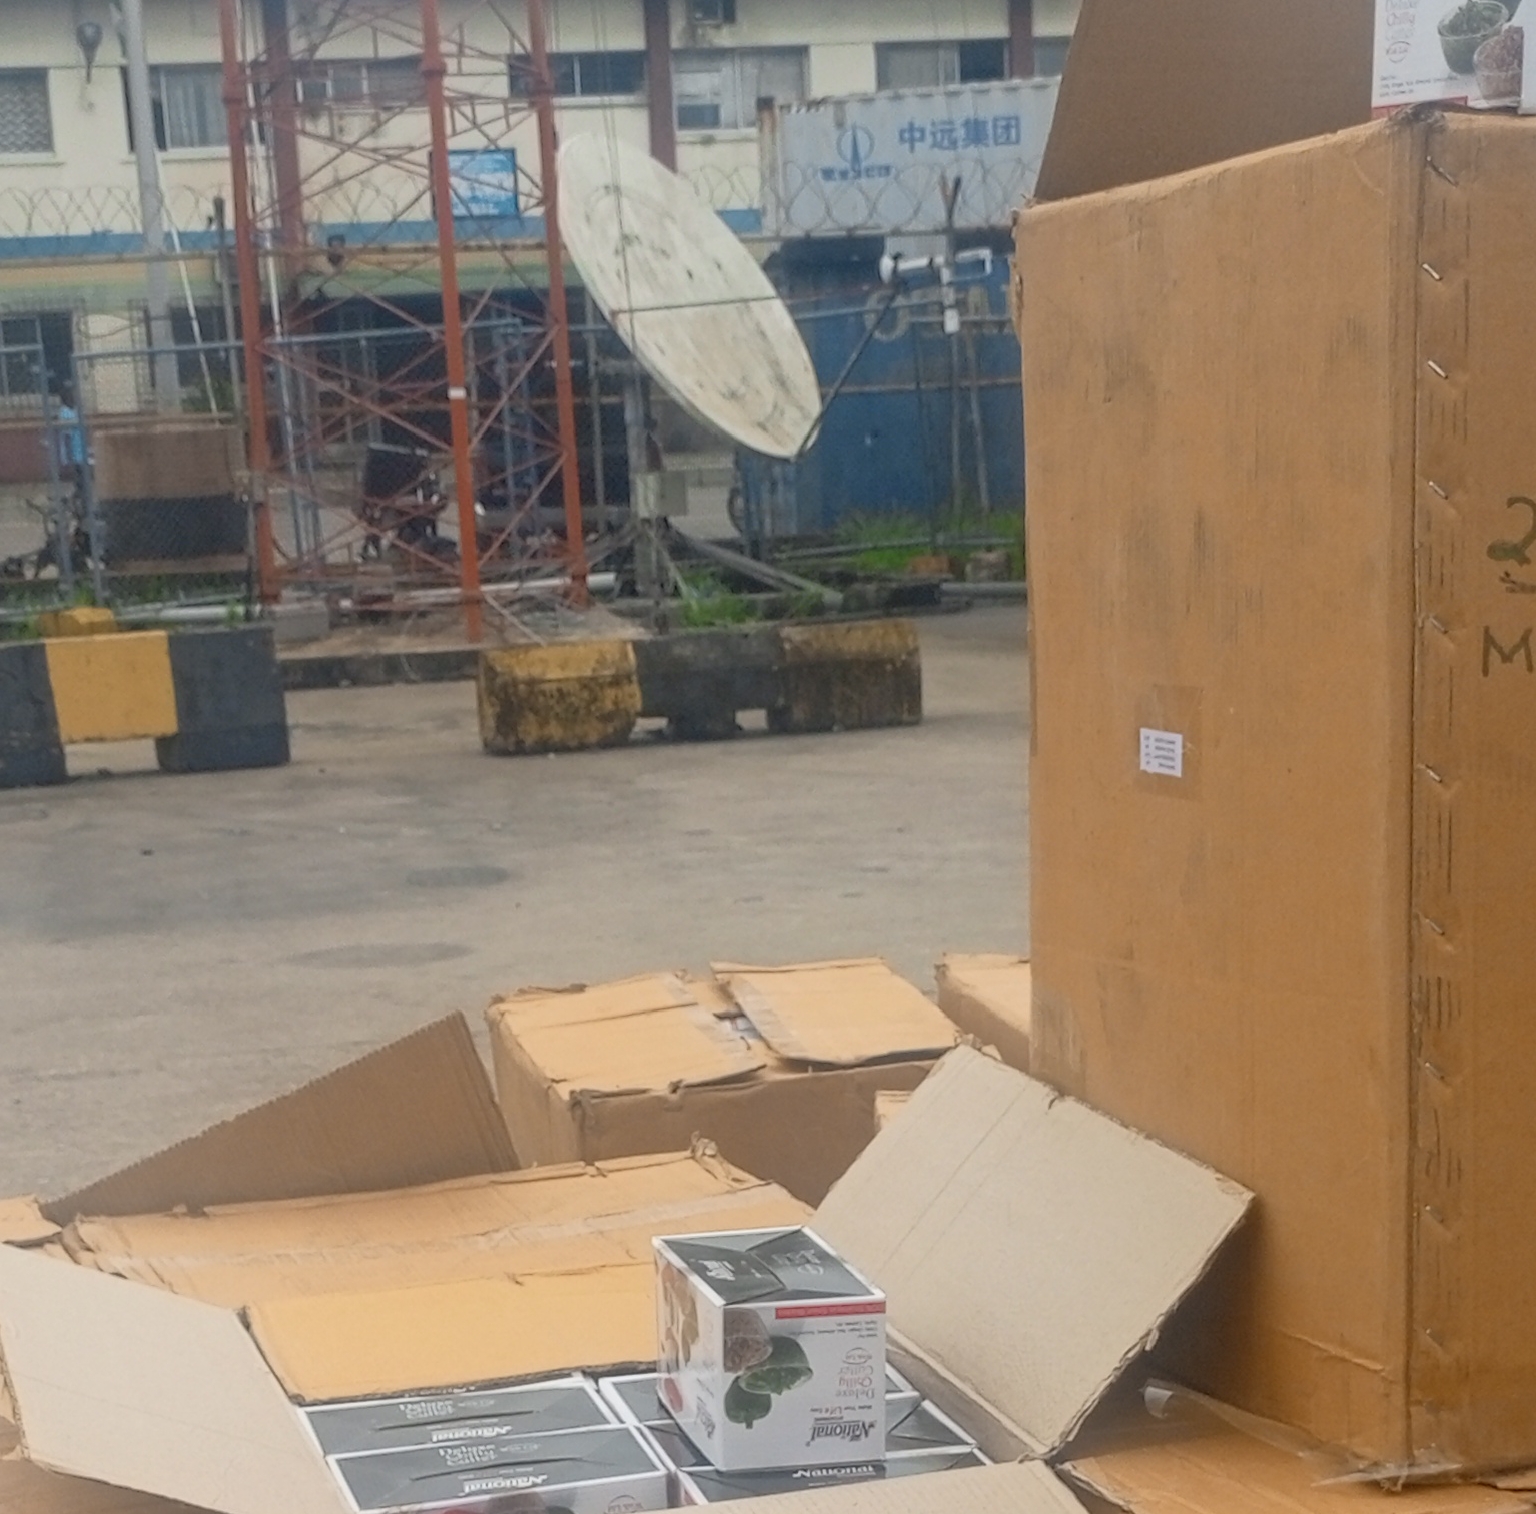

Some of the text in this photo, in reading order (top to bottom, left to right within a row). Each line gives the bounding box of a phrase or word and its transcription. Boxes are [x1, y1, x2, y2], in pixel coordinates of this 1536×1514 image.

[898, 114, 1021, 153] 中远集团
[431, 1425, 513, 1443] National
[811, 1420, 877, 1442] National
[463, 1474, 548, 1494] National
